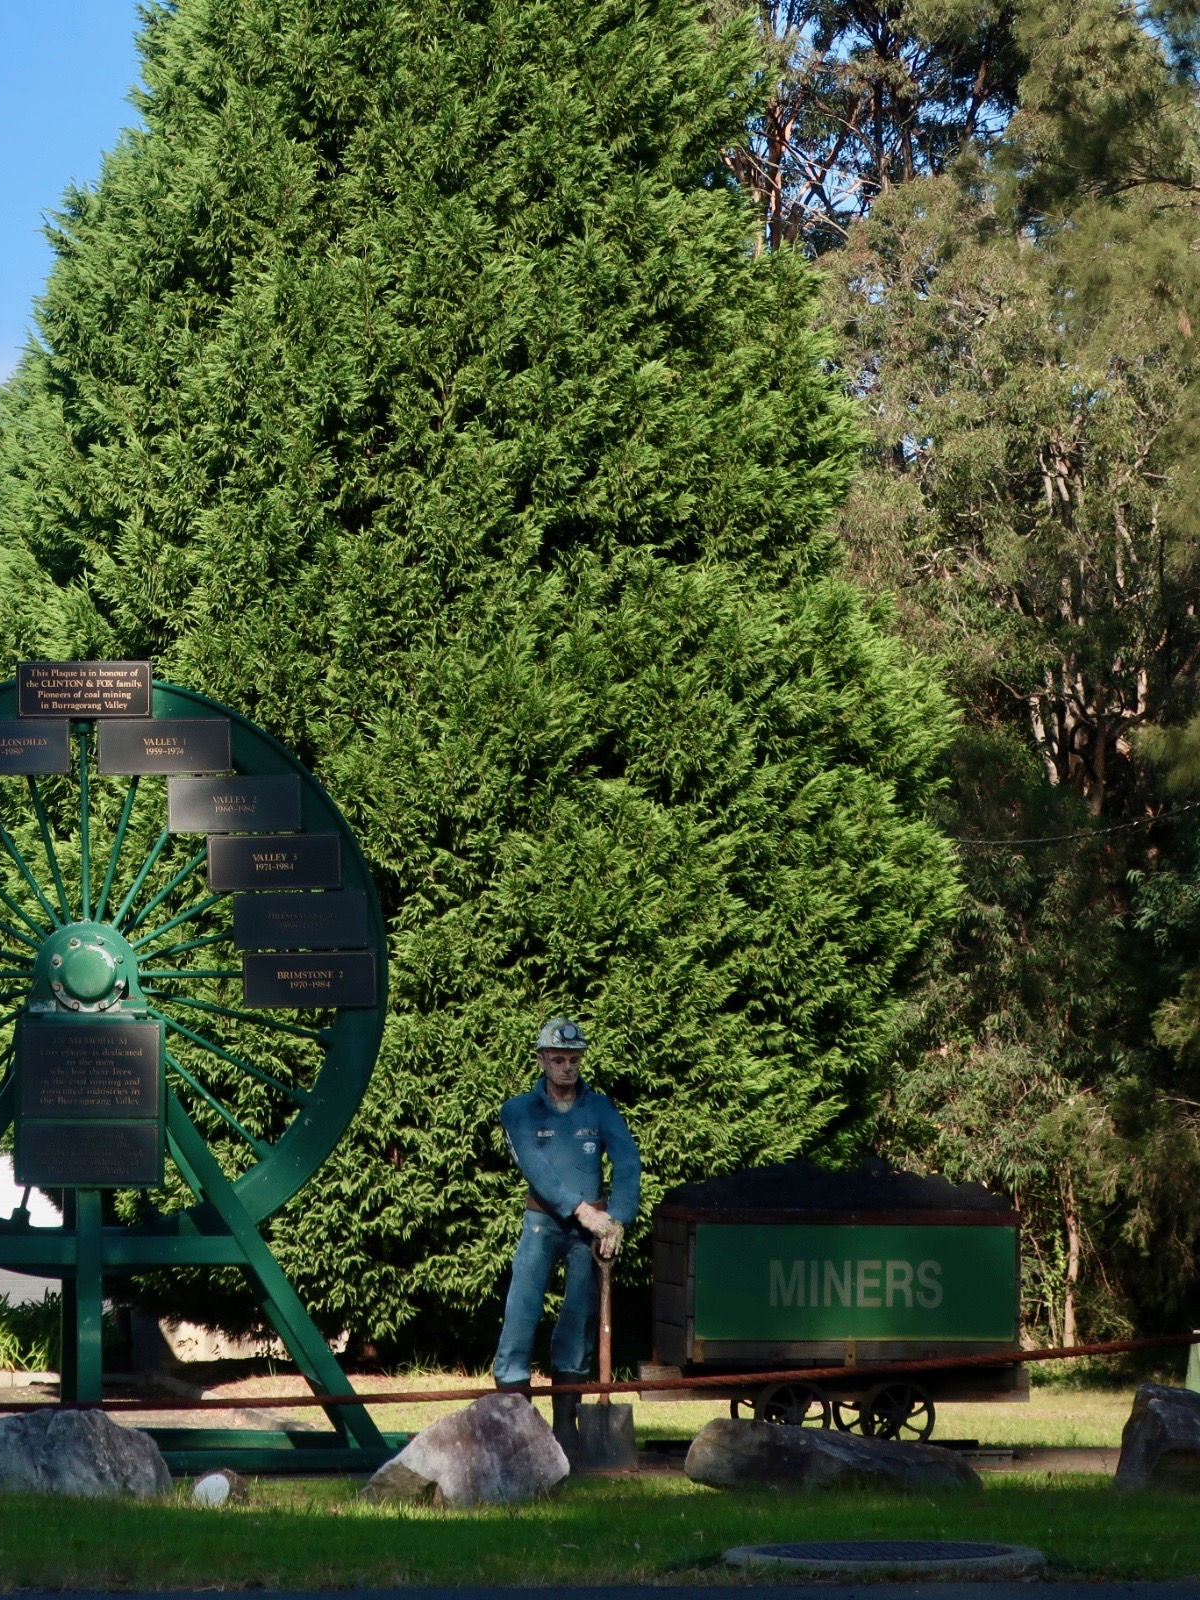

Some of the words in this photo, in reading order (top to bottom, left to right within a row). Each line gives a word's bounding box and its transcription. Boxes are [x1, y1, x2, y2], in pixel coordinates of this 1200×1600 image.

[31, 669, 48, 677] This
[51, 669, 77, 678] Plaque
[100, 669, 127, 677] honour
[130, 669, 139, 677] of
[41, 680, 83, 688] CLINTON
[86, 680, 94, 688] &
[97, 680, 113, 688] FOX
[103, 691, 131, 700] mining
[52, 702, 101, 711] Burragorang
[105, 702, 127, 710] Valley
[143, 738, 178, 746] VALLEY
[253, 853, 287, 862] VALLEY
[255, 863, 294, 871] 1971-1984
[339, 971, 344, 979] 2
[90, 1078, 121, 1086] mining
[87, 1087, 128, 1095] industries
[131, 1087, 140, 1095] in
[115, 1097, 139, 1106] Valley
[769, 1259, 944, 1308] MINERS
